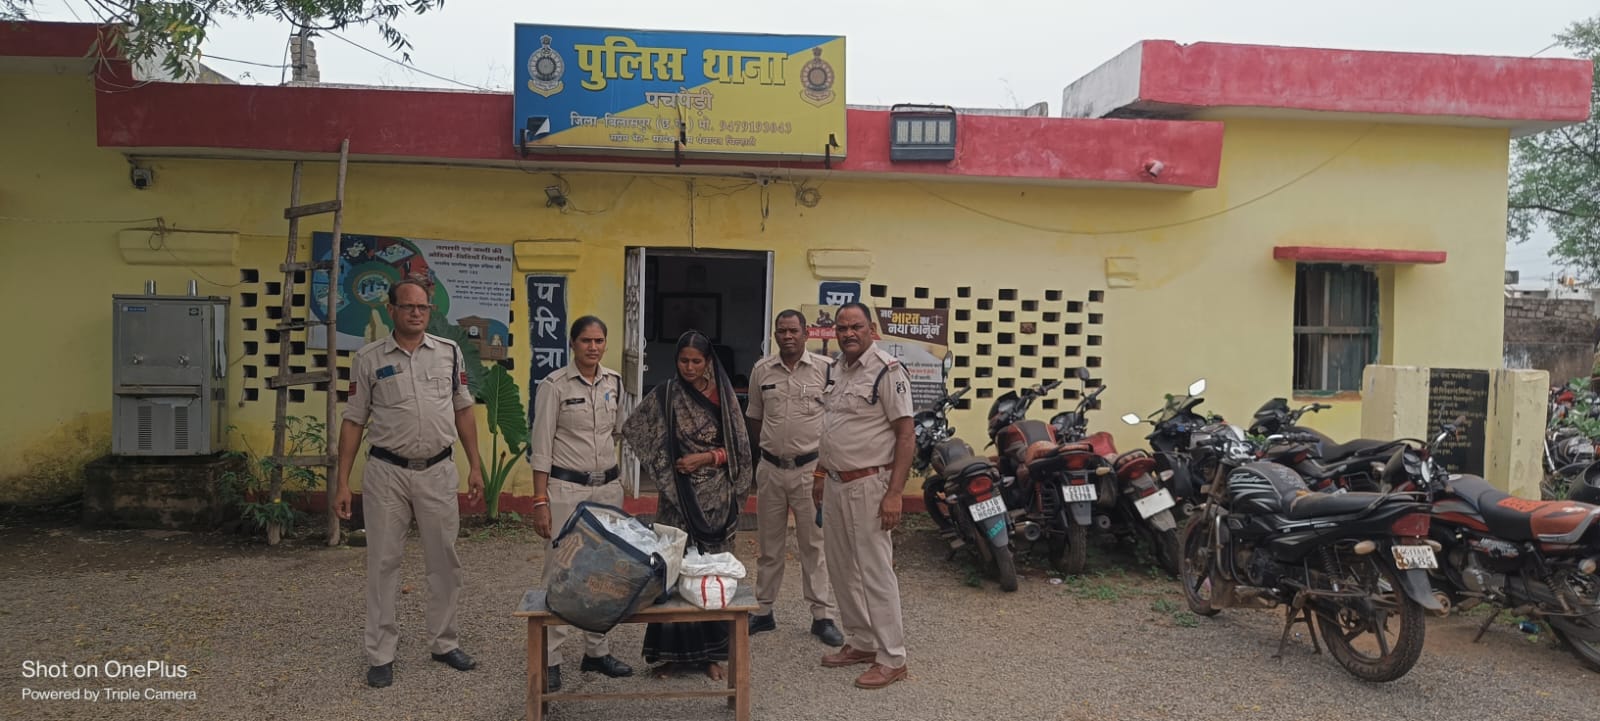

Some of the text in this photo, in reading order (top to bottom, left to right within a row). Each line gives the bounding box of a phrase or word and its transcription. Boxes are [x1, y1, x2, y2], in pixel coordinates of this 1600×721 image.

[574, 36, 788, 91] पुलिस थाना
[570, 112, 598, 128] जिला
[892, 313, 920, 324] भारत
[920, 316, 930, 325] का
[534, 282, 565, 386] परित्रा
[887, 323, 941, 340] नया कानून
